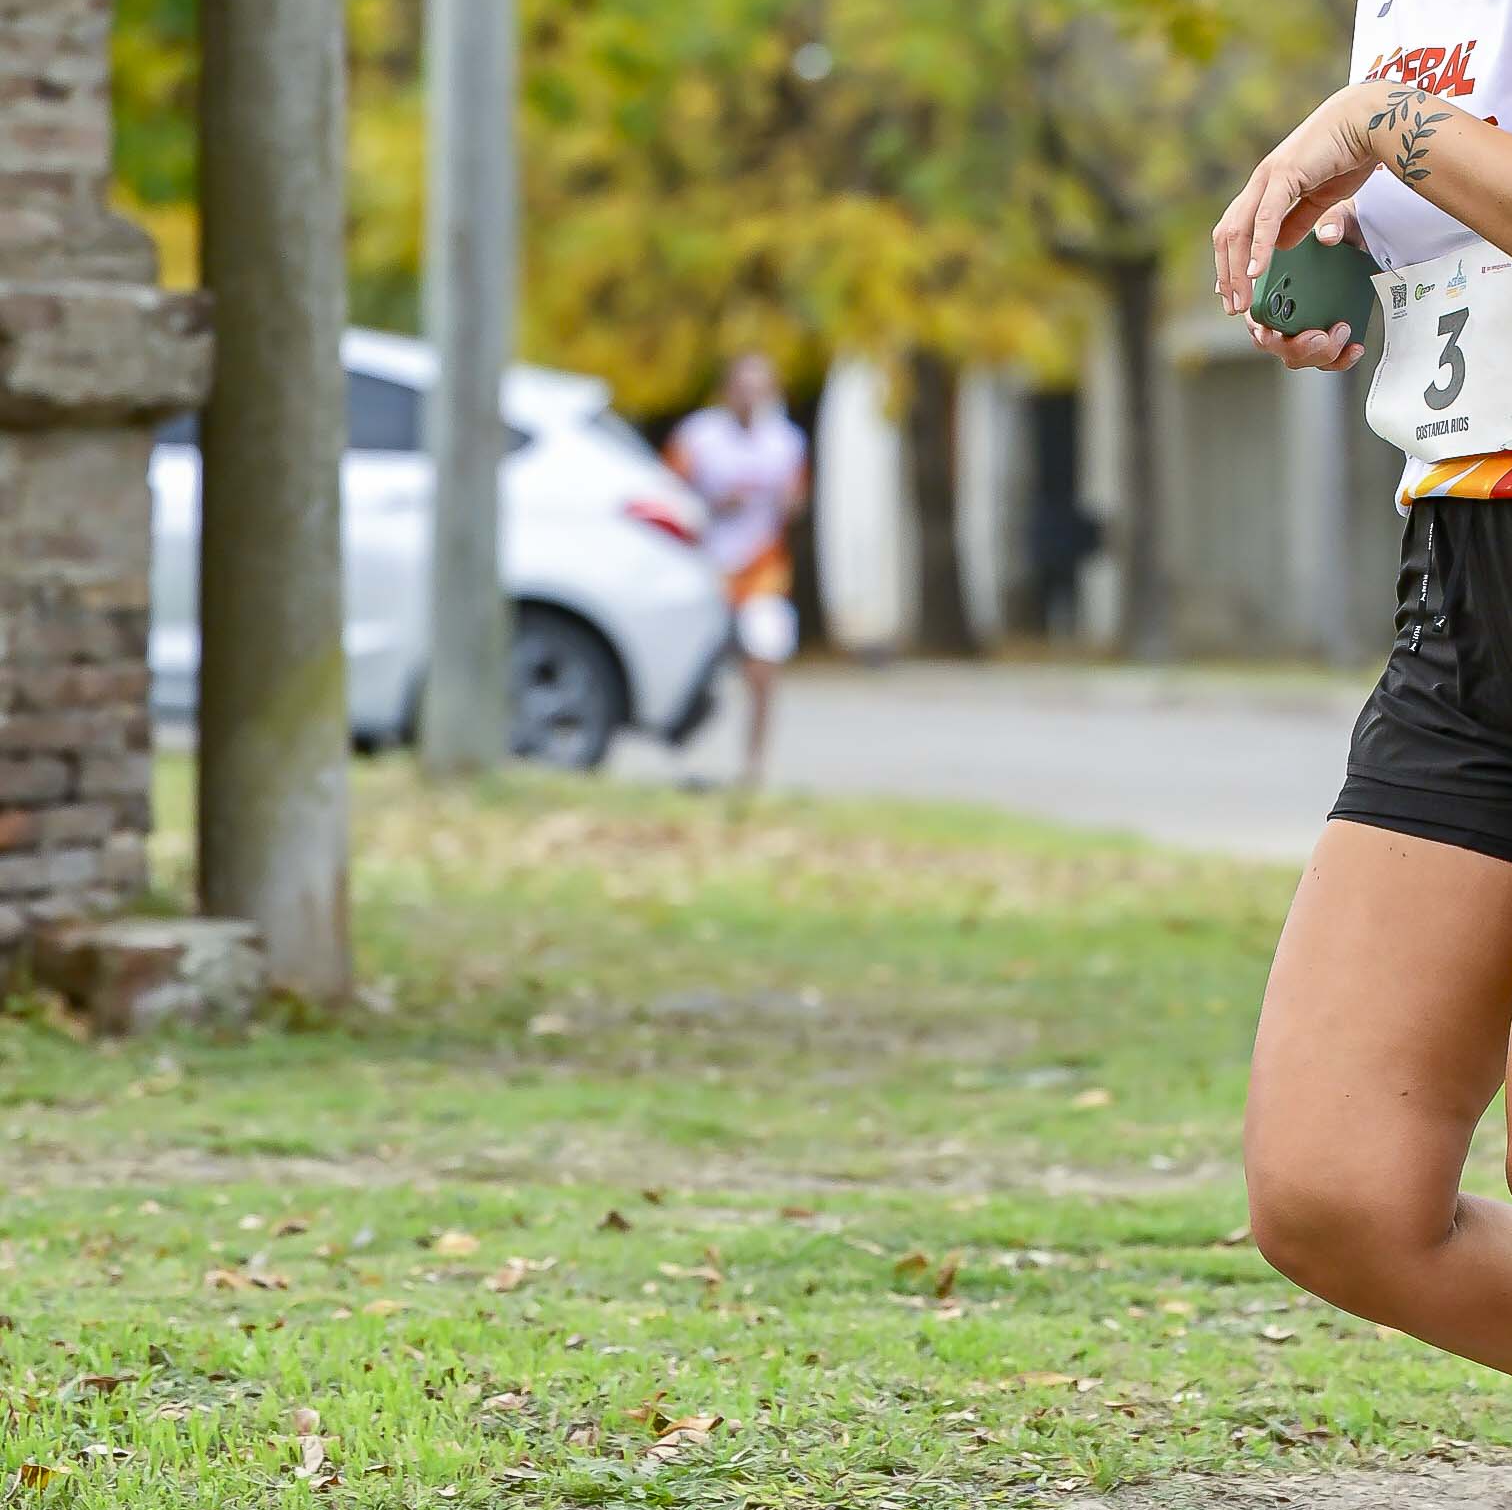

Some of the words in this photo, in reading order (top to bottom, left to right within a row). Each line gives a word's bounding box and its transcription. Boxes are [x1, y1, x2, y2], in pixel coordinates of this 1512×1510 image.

[1424, 306, 1470, 411] 3
[1415, 419, 1449, 441] COSTANZA
[1450, 416, 1469, 434] RIOS
